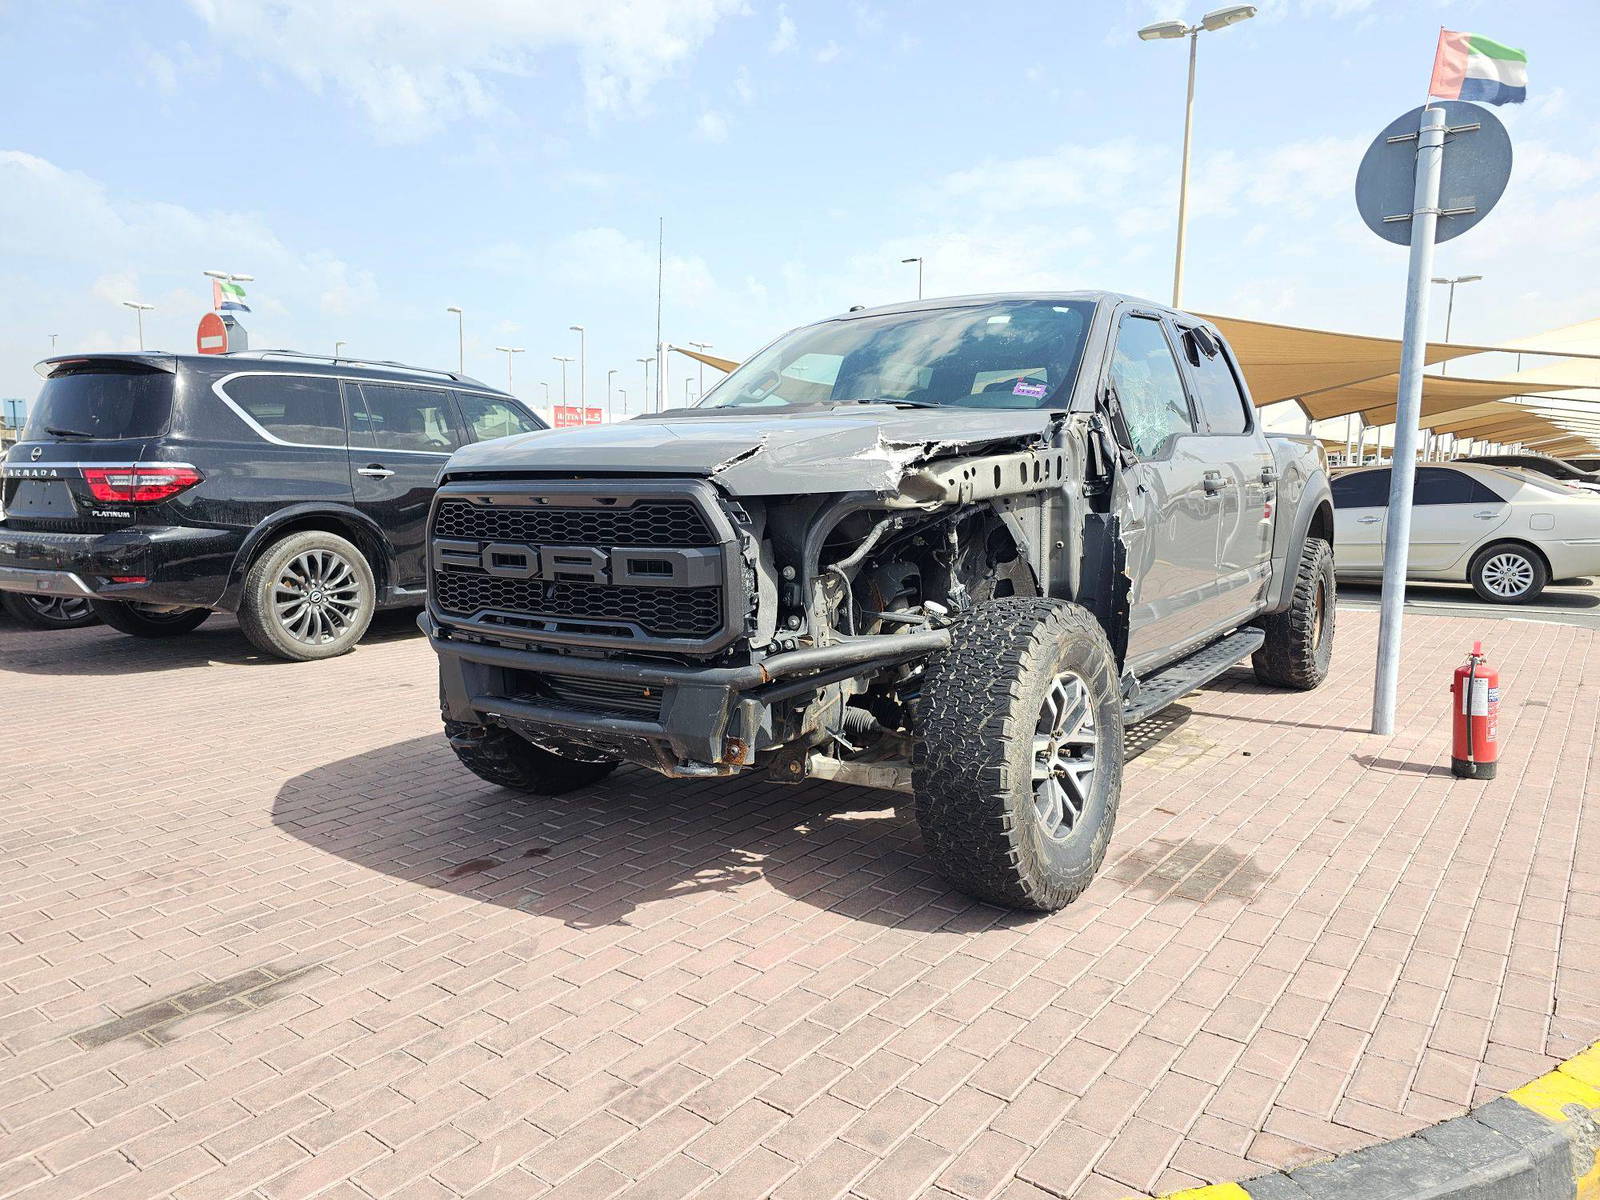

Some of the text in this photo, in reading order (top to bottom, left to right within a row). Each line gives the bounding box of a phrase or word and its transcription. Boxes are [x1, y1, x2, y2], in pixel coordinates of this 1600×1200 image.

[7, 469, 57, 477] ARMADA
[91, 510, 131, 518] PLATINUM
[432, 538, 702, 587] FORD
